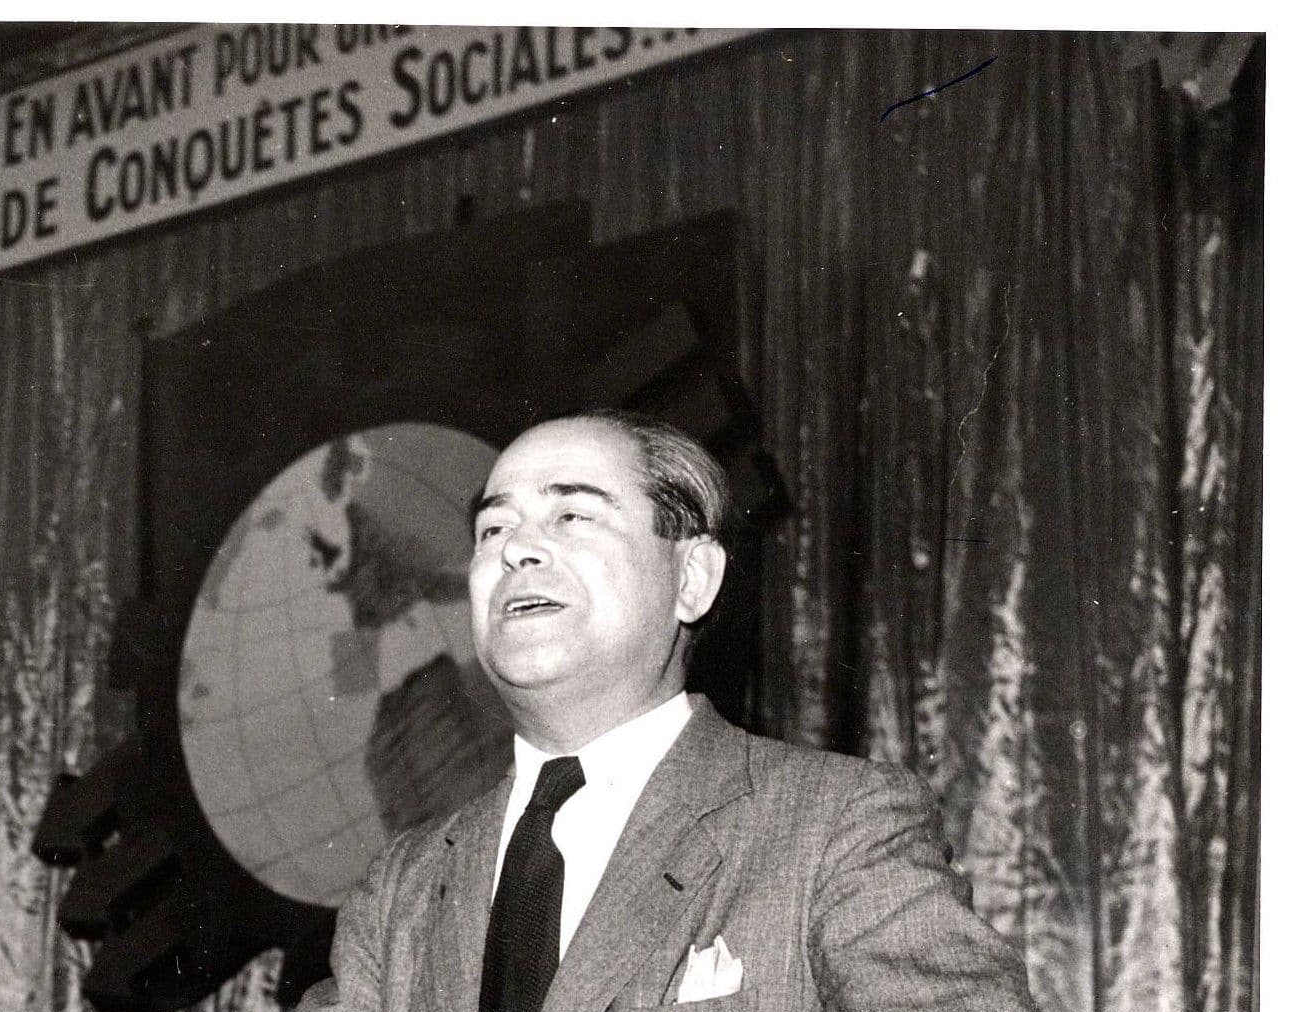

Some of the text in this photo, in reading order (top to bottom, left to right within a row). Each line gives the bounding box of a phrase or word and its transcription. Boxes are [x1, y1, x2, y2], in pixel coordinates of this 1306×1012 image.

[0, 177, 60, 249] DE
[86, 79, 364, 223] CONQUÊTES
[2, 96, 54, 166] EN
[68, 45, 195, 148] AVANT
[213, 24, 322, 97] POUR
